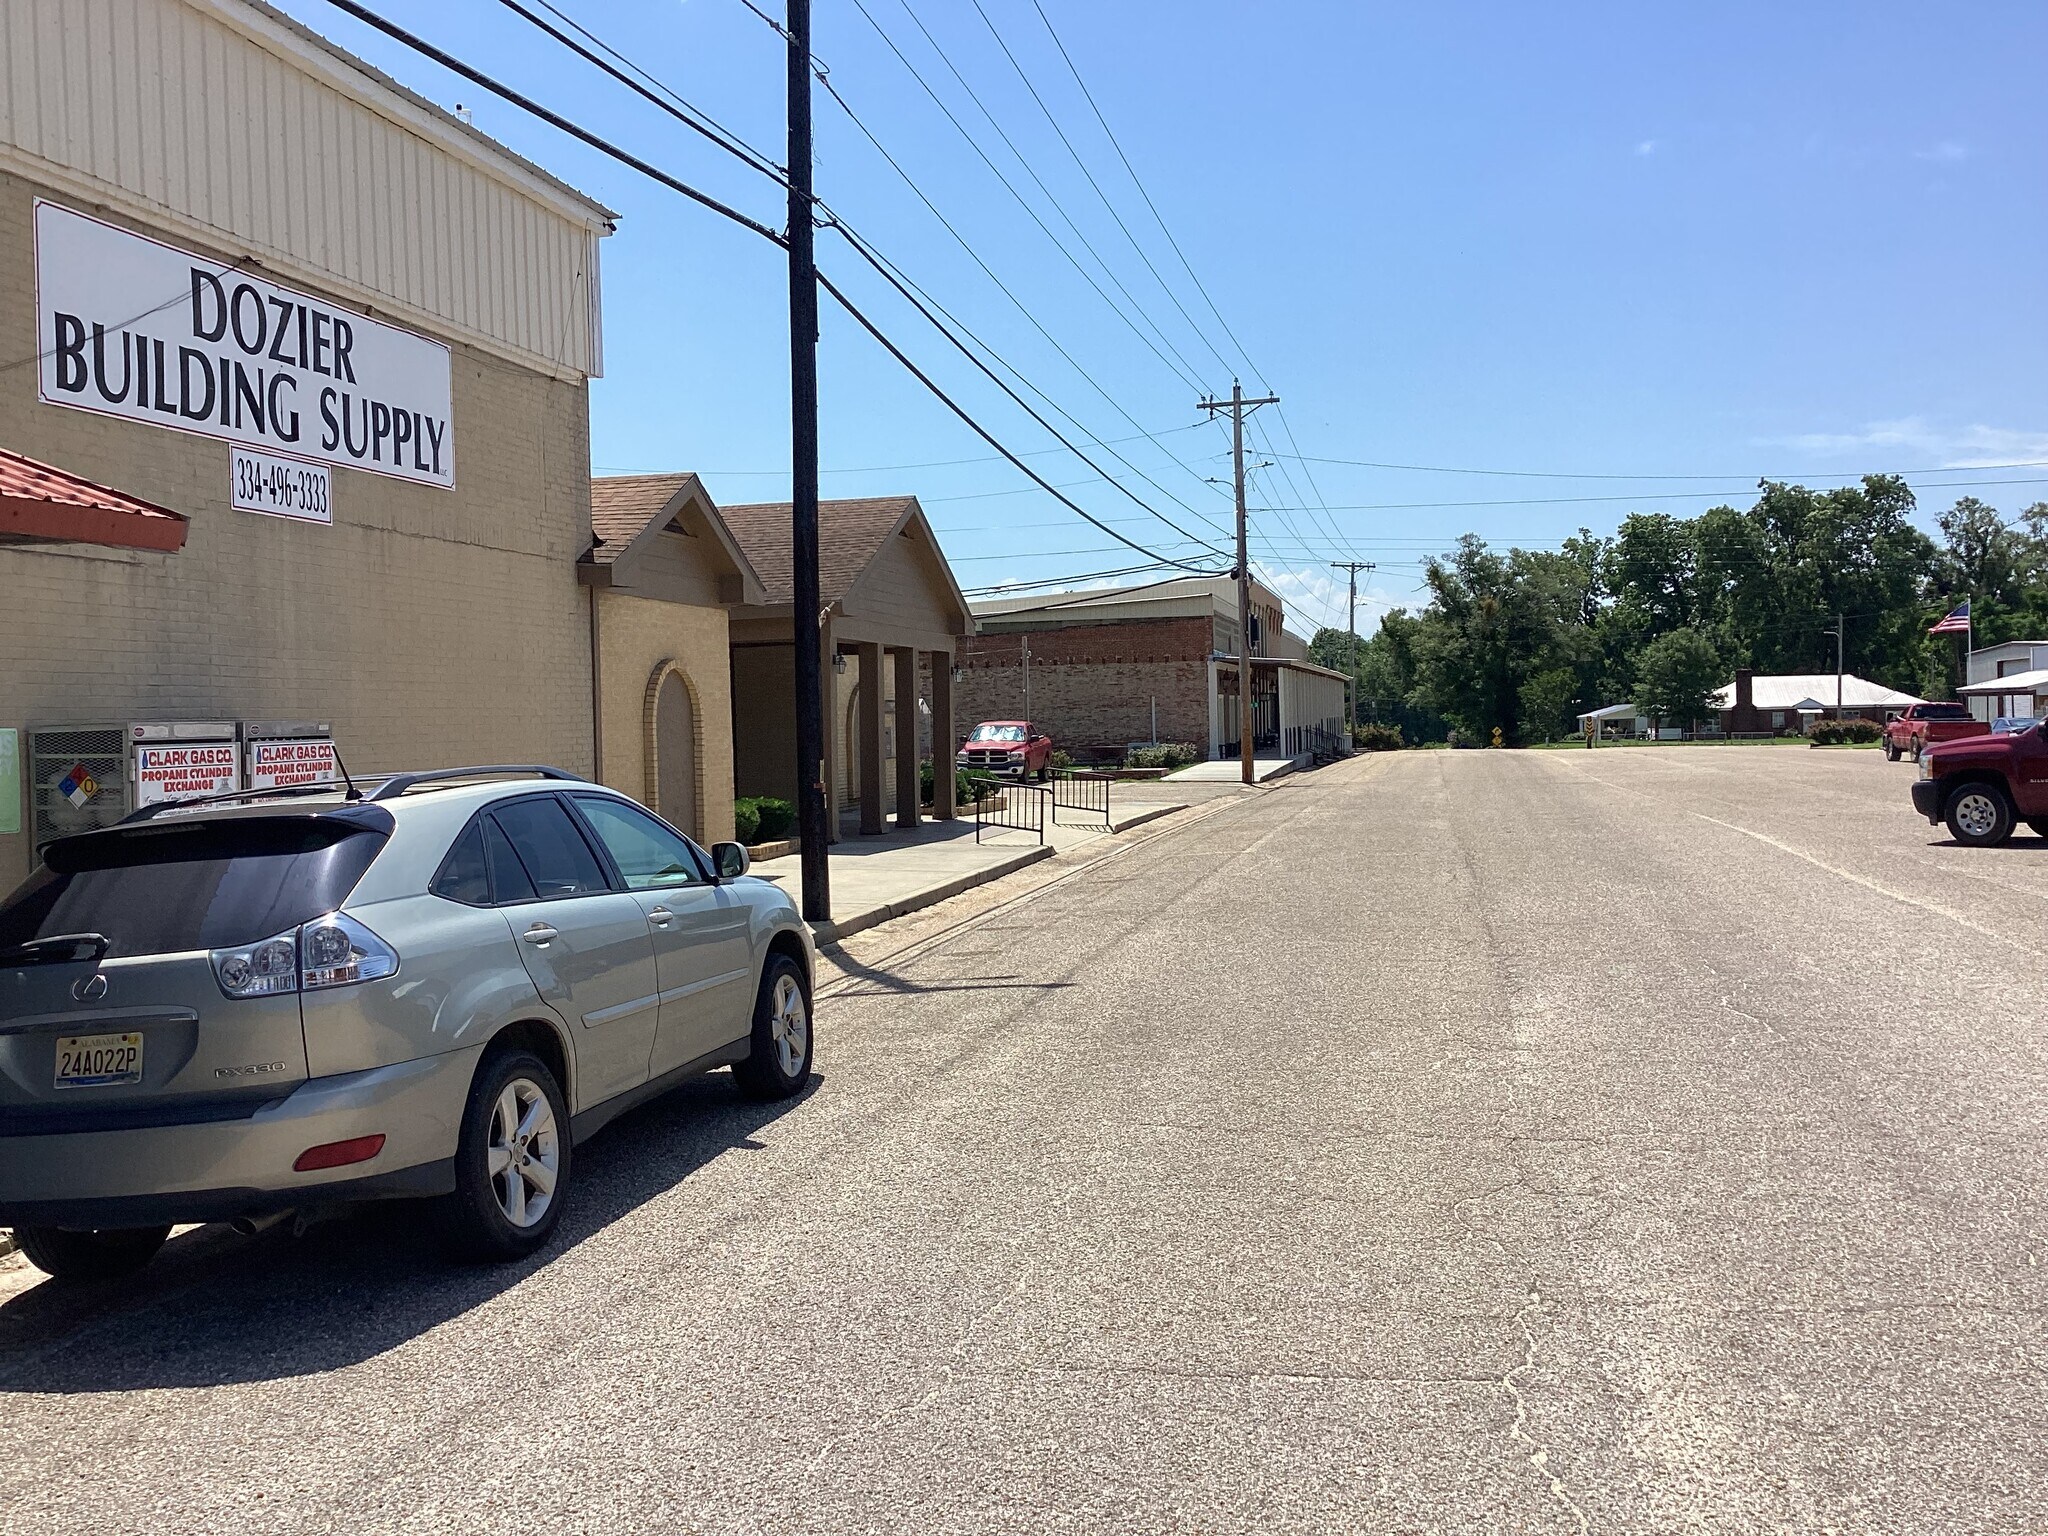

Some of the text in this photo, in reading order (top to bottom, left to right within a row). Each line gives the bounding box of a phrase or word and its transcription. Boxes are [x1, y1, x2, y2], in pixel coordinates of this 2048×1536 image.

[190, 266, 357, 386] DOZIER
[54, 311, 445, 475] BUILDING SUPPLY
[238, 457, 327, 514] 334-496-3333
[148, 749, 233, 766] CLARK GAS CO.
[262, 745, 333, 761] CLARK GAS CO.
[141, 767, 233, 781] PROPANE CYLINDER
[256, 761, 332, 775] PROPANE CYLINDER
[84, 778, 94, 793] 0
[164, 780, 214, 792] EXCHANGE
[275, 773, 316, 786] EXCHANGE
[61, 1047, 136, 1076] 24A022P
